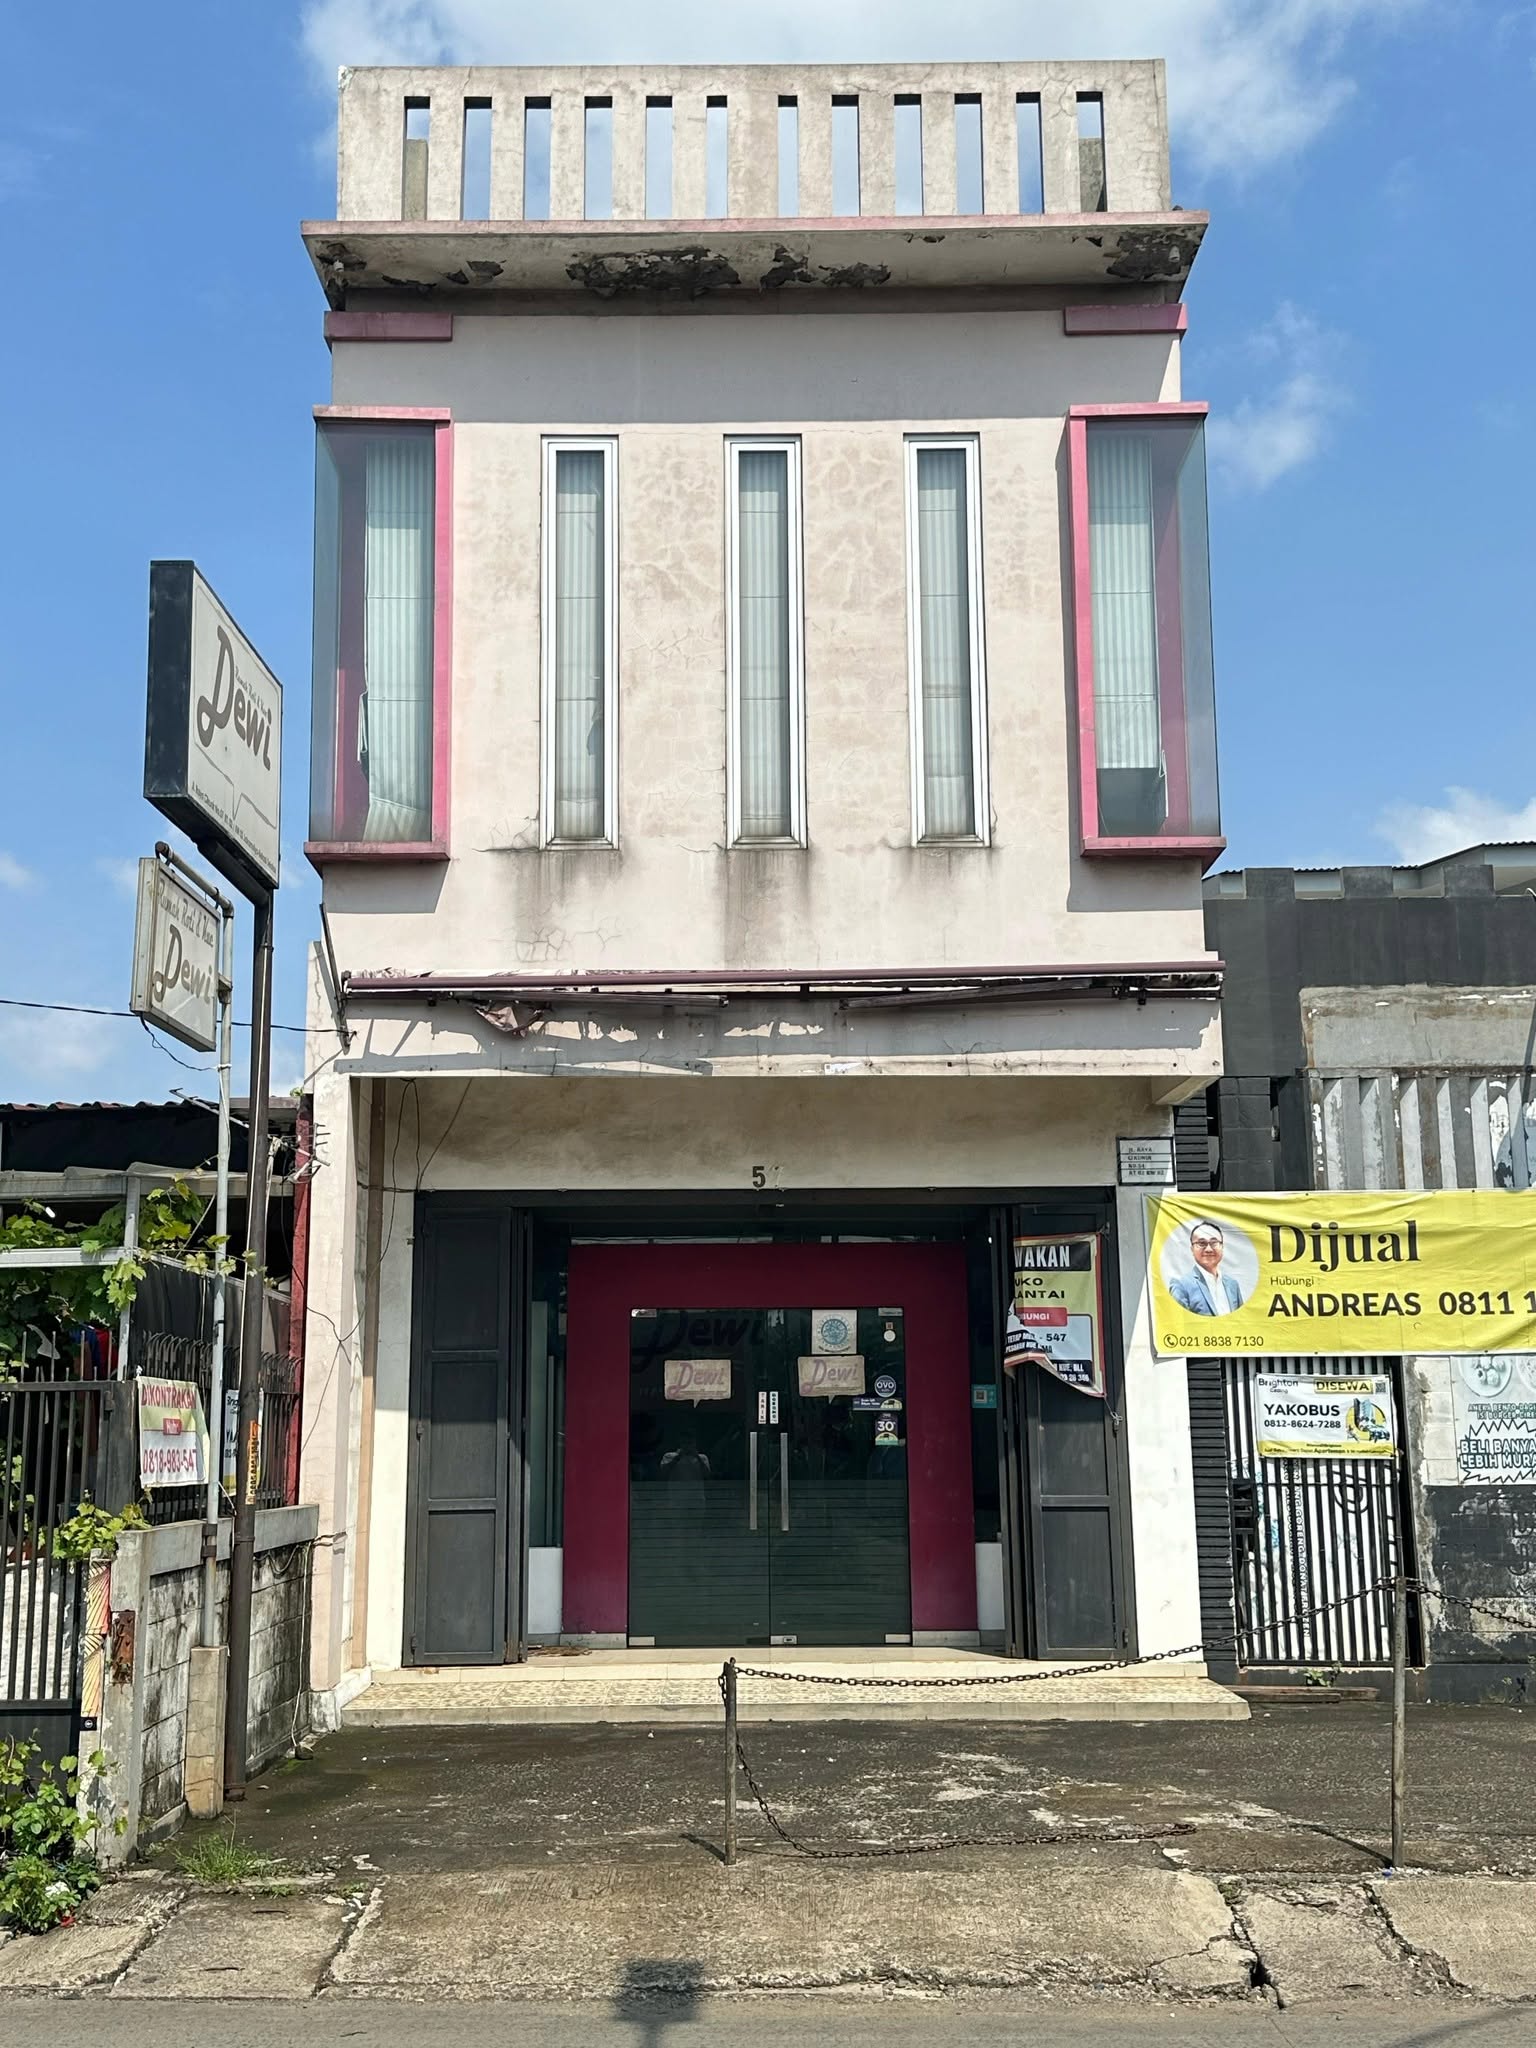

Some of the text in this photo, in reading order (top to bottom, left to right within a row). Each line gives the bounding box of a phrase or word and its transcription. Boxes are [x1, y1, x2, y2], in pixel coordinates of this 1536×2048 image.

[197, 625, 272, 771] Dewi
[153, 923, 212, 1005] Dewi
[1269, 1220, 1421, 1273] Dijual
[1270, 1276, 1315, 1288] Hubungi
[1268, 1293, 1421, 1317] ANDREAS
[1438, 1290, 1514, 1316] 0811
[1046, 1333, 1067, 1342] 547
[1179, 1335, 1264, 1347] 021 8838 7130
[666, 1362, 725, 1399] Dewi
[801, 1359, 859, 1395] Dewi
[876, 1381, 895, 1389] OVO
[1258, 1378, 1369, 1391] Brighton DISEWA
[1264, 1403, 1341, 1417] YAKOBUS
[1264, 1419, 1342, 1429] 0812-8624-7288
[1460, 1439, 1491, 1454] BELI
[1460, 1454, 1499, 1468] LEBIH
